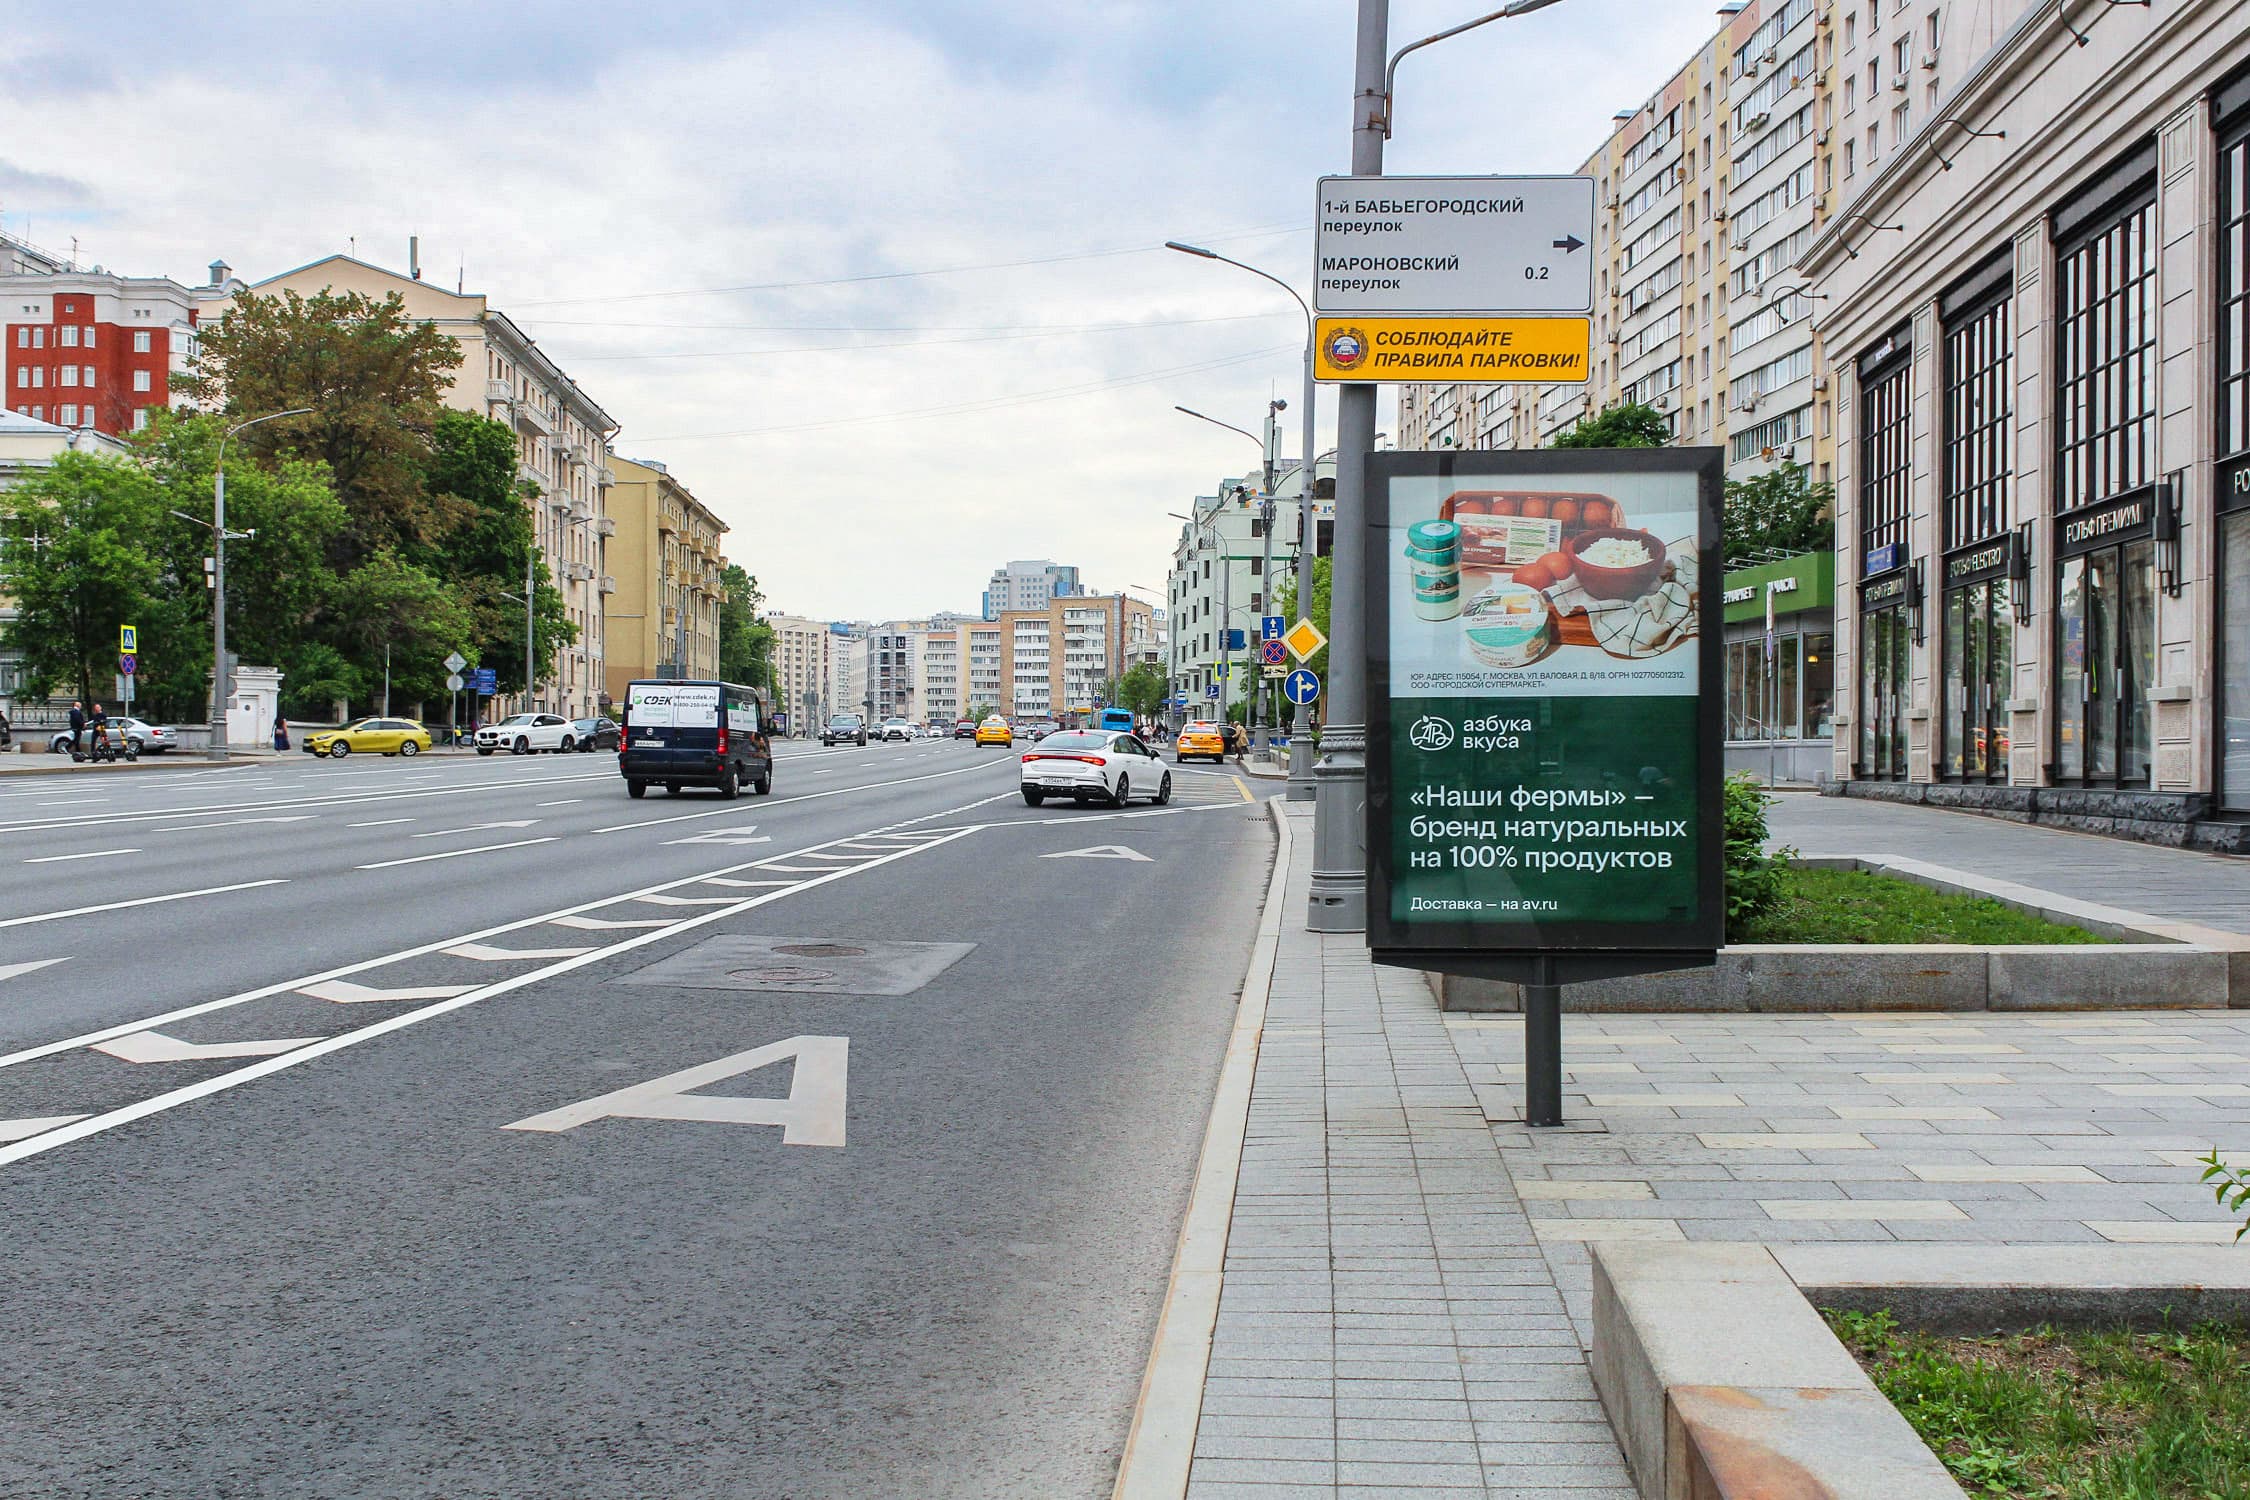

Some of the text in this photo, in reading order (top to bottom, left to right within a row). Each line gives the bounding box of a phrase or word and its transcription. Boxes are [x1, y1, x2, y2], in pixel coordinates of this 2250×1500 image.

[1324, 197, 1524, 214] 1-й БАБЬЕГОРОДСКИЙ
[1323, 221, 1403, 234] переулок
[1322, 255, 1459, 271] МАРОНОВСКИЙ
[1525, 266, 1549, 280] 0.2
[1321, 278, 1401, 292] переулок
[1375, 329, 1513, 349] СОБЛЮДАЙТЕ
[1374, 353, 1580, 368] ПРАВИЛА ПАРКОВКИ!
[2066, 503, 2141, 544] РОЛЬФ ПРЕМИУМ
[1972, 547, 2001, 571] ELECTRO
[1608, 672, 1629, 680] ОГРН
[1411, 681, 1430, 689] ООО
[643, 696, 673, 706] CDEK
[1463, 715, 1531, 735] азбука
[1463, 736, 1519, 752] вкуса
[1410, 784, 1502, 808] «Наши
[1510, 784, 1626, 812] фермы»
[1410, 815, 1687, 842] бренд натуральных
[1410, 845, 1672, 873] на 100% продуктов
[1410, 896, 1482, 911] Доставка
[1501, 900, 1519, 910] на
[1522, 899, 1558, 911] av.ru
